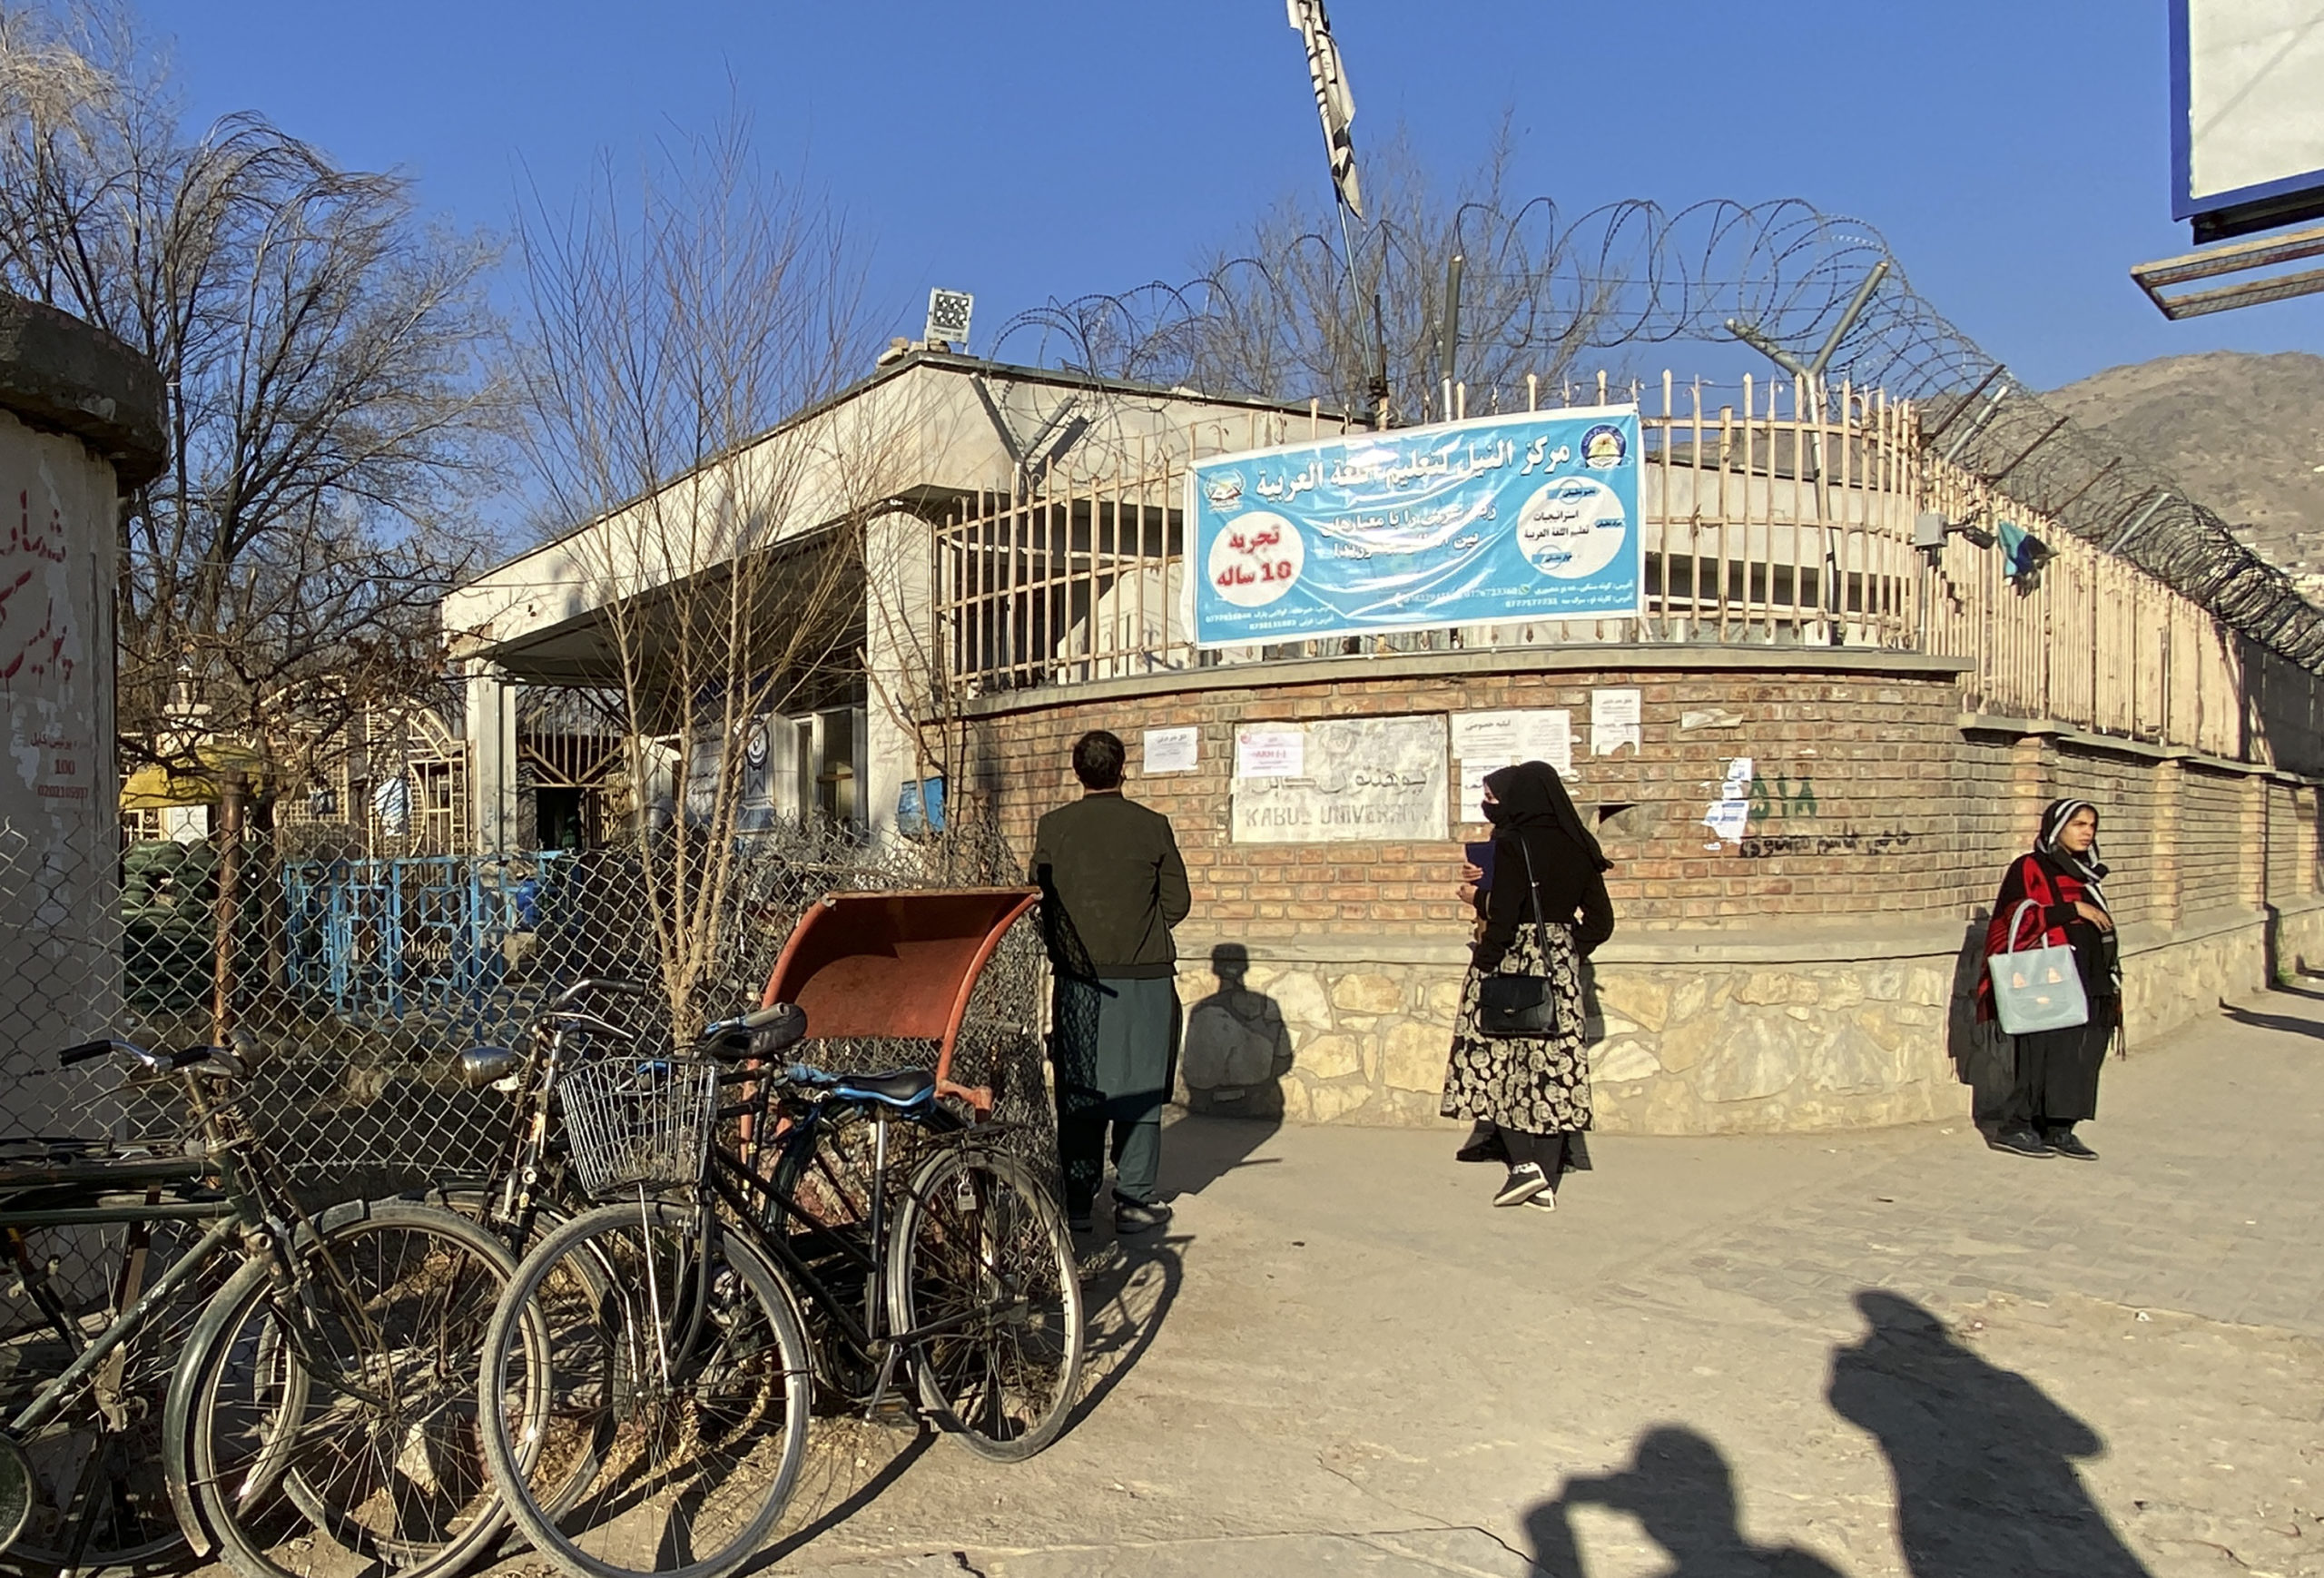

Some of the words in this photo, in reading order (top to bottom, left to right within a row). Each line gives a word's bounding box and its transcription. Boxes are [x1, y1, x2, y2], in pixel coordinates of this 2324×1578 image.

[1520, 435, 1571, 475] مركز
[1256, 461, 1324, 505] العربية
[1388, 509, 1400, 529] با
[1217, 565, 1256, 587] ساله
[1261, 561, 1292, 582] 10
[54, 759, 75, 775] 100
[1246, 806, 1313, 826] KABUL
